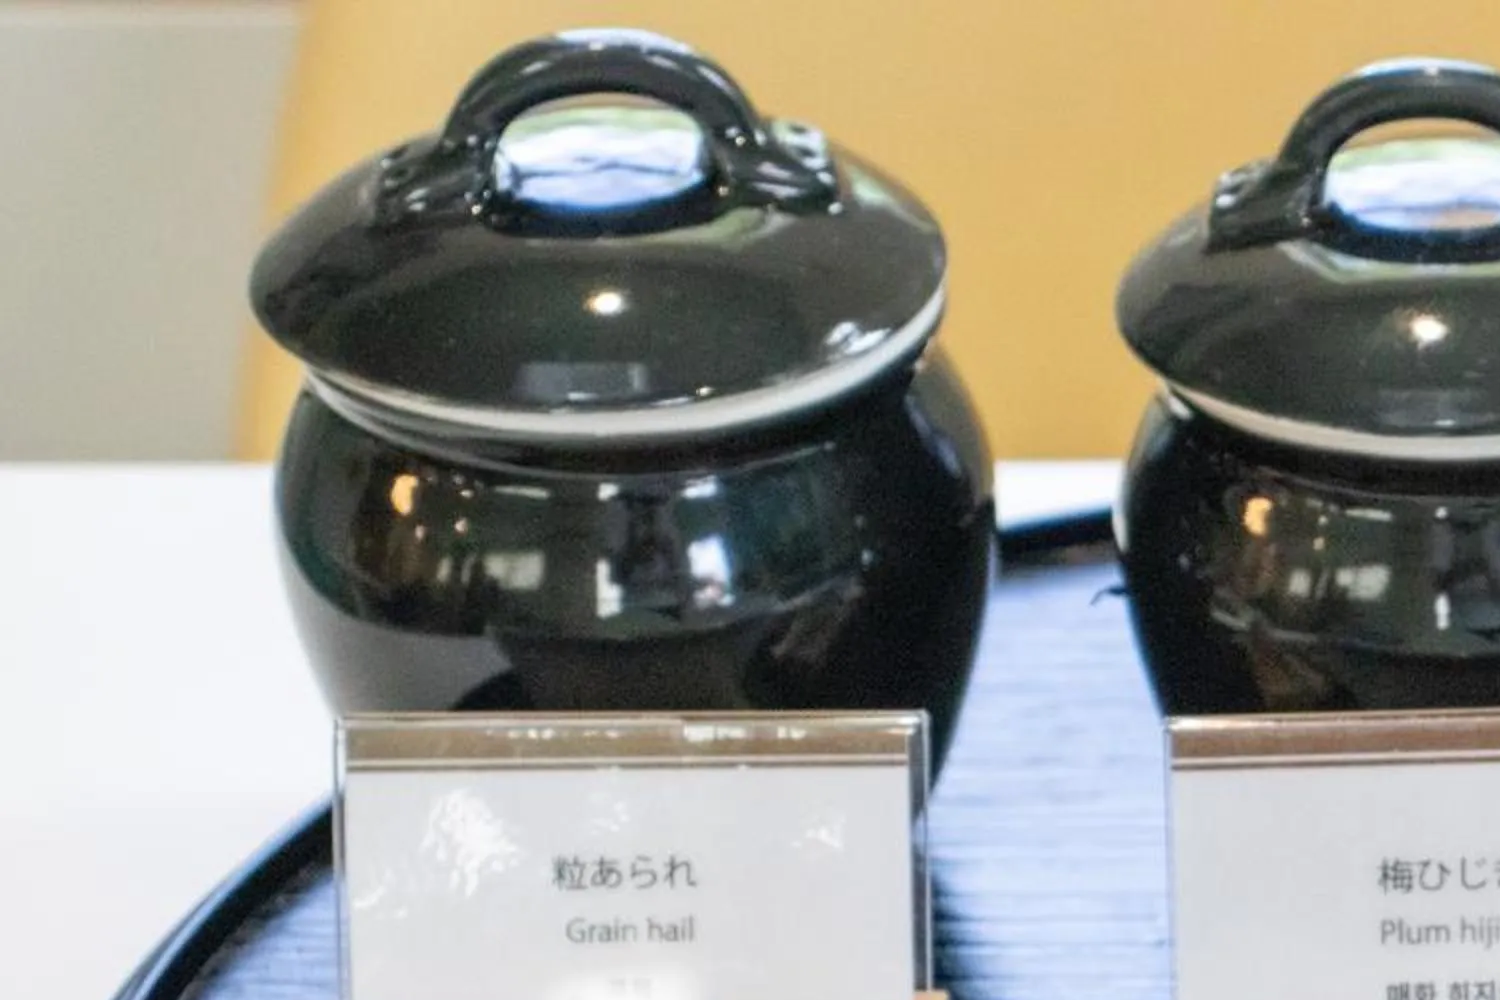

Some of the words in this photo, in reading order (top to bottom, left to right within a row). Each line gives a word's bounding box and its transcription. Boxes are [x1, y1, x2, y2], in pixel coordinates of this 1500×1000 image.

[552, 856, 698, 890] 粒あられ
[565, 917, 638, 944] Grain
[648, 914, 695, 942] hail
[1380, 917, 1450, 946] Plum
